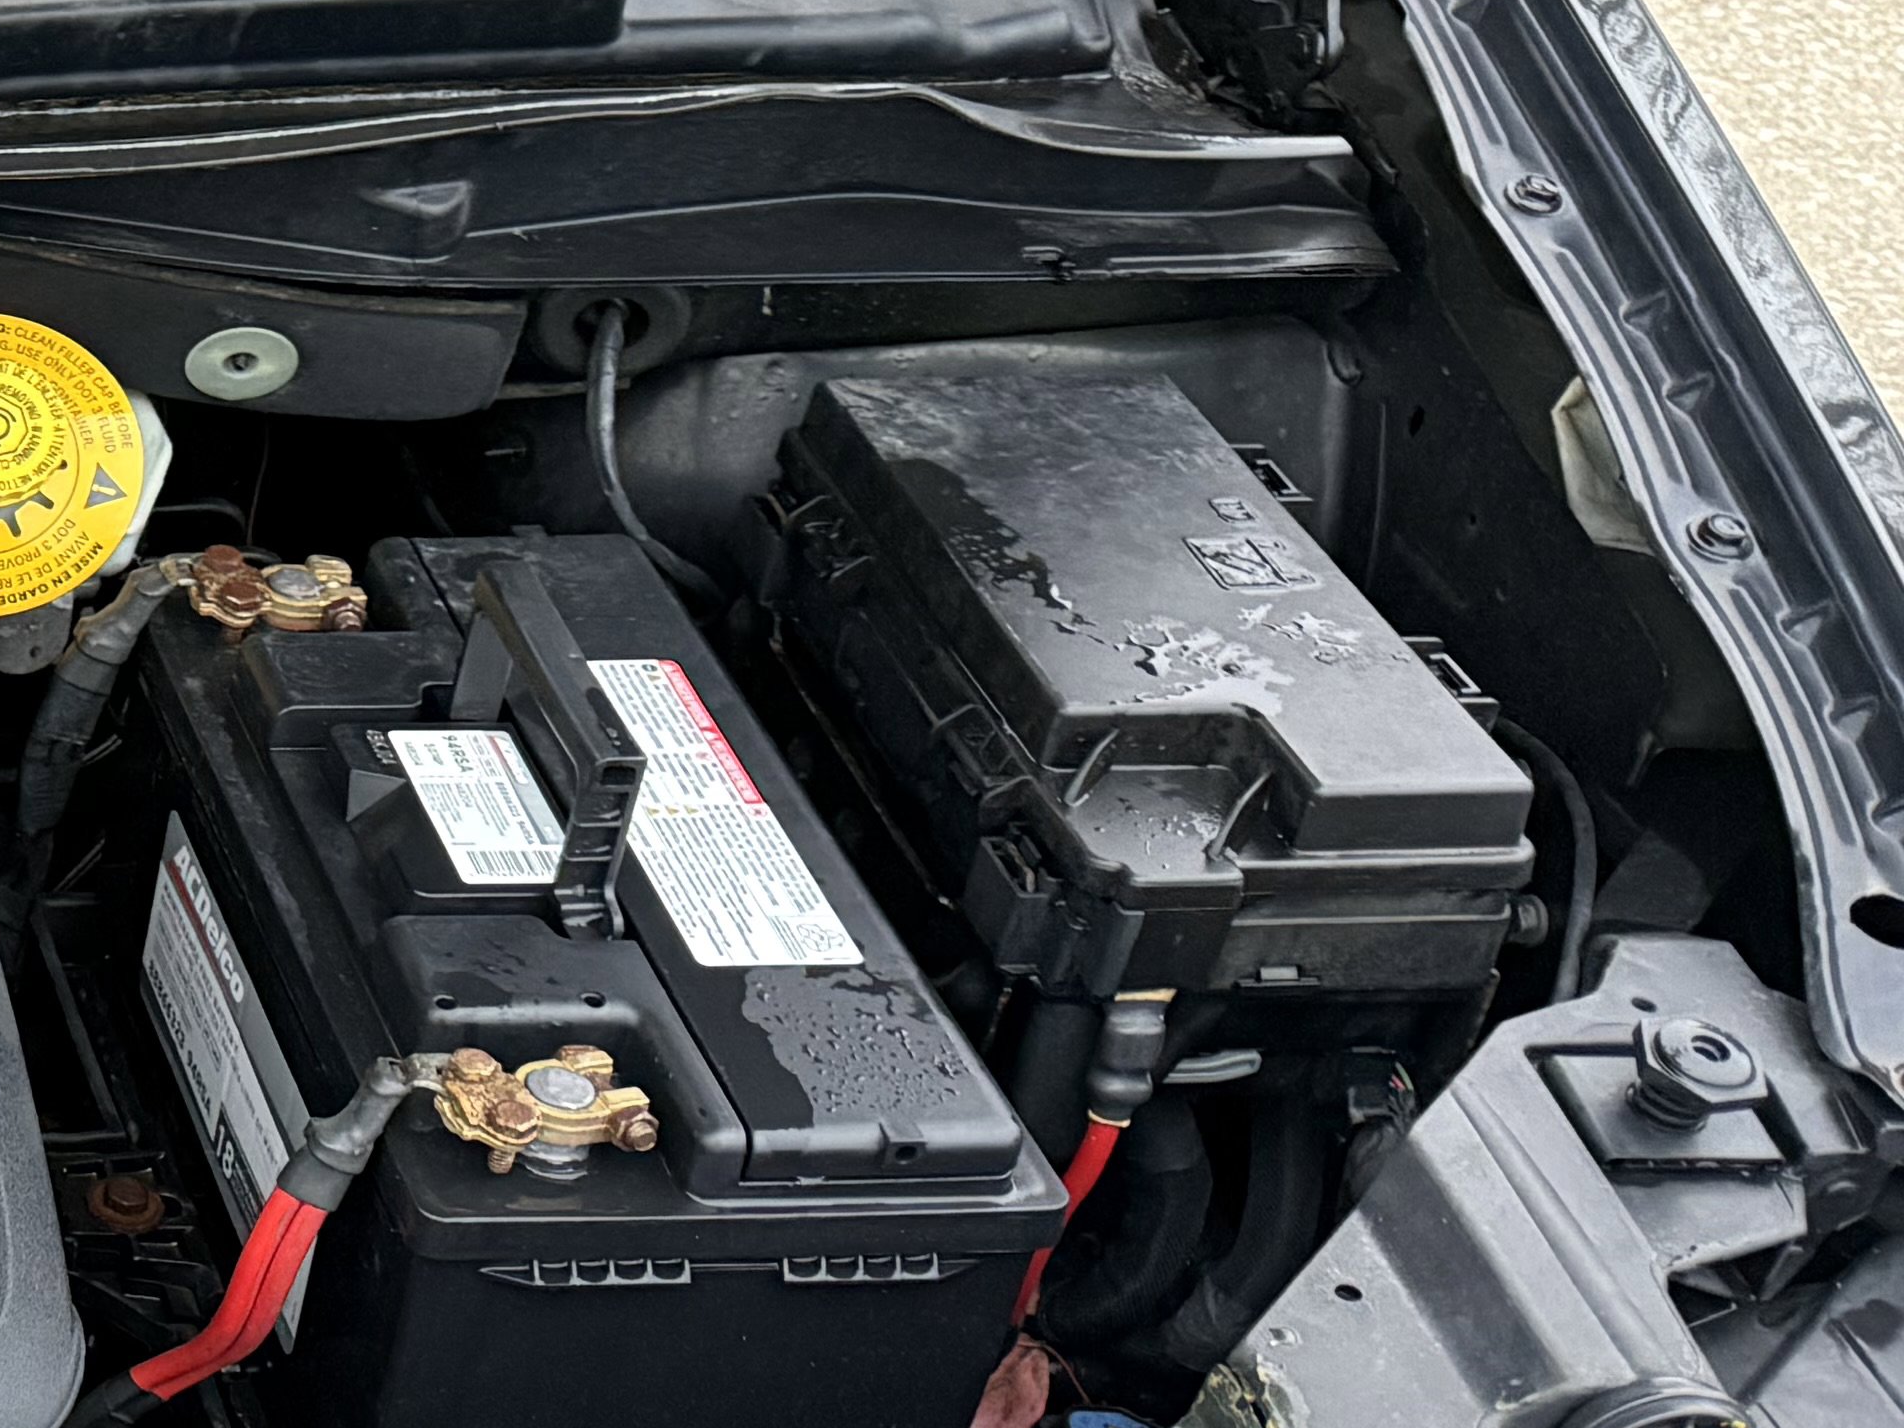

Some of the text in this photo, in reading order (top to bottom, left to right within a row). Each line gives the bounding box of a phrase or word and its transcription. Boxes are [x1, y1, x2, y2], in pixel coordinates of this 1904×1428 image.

[16, 344, 42, 361] USE
[43, 355, 76, 380] ONLY
[15, 326, 56, 351] CLEAN
[57, 345, 95, 378] FILLER
[92, 375, 113, 400] CAP
[108, 400, 133, 449] BEFORE
[74, 379, 98, 404] DOT
[0, 383, 42, 420] REMOVING
[91, 406, 103, 415] 3
[96, 416, 117, 453] FLUID
[55, 518, 76, 544] DOT
[42, 541, 53, 551] 3
[57, 531, 90, 568] AVANT
[74, 542, 103, 573] MISE
[18, 572, 32, 582] LE
[37, 562, 52, 578] DE
[52, 571, 72, 588] EN
[173, 845, 245, 1003] ACDelco
[216, 1124, 235, 1179] 18
